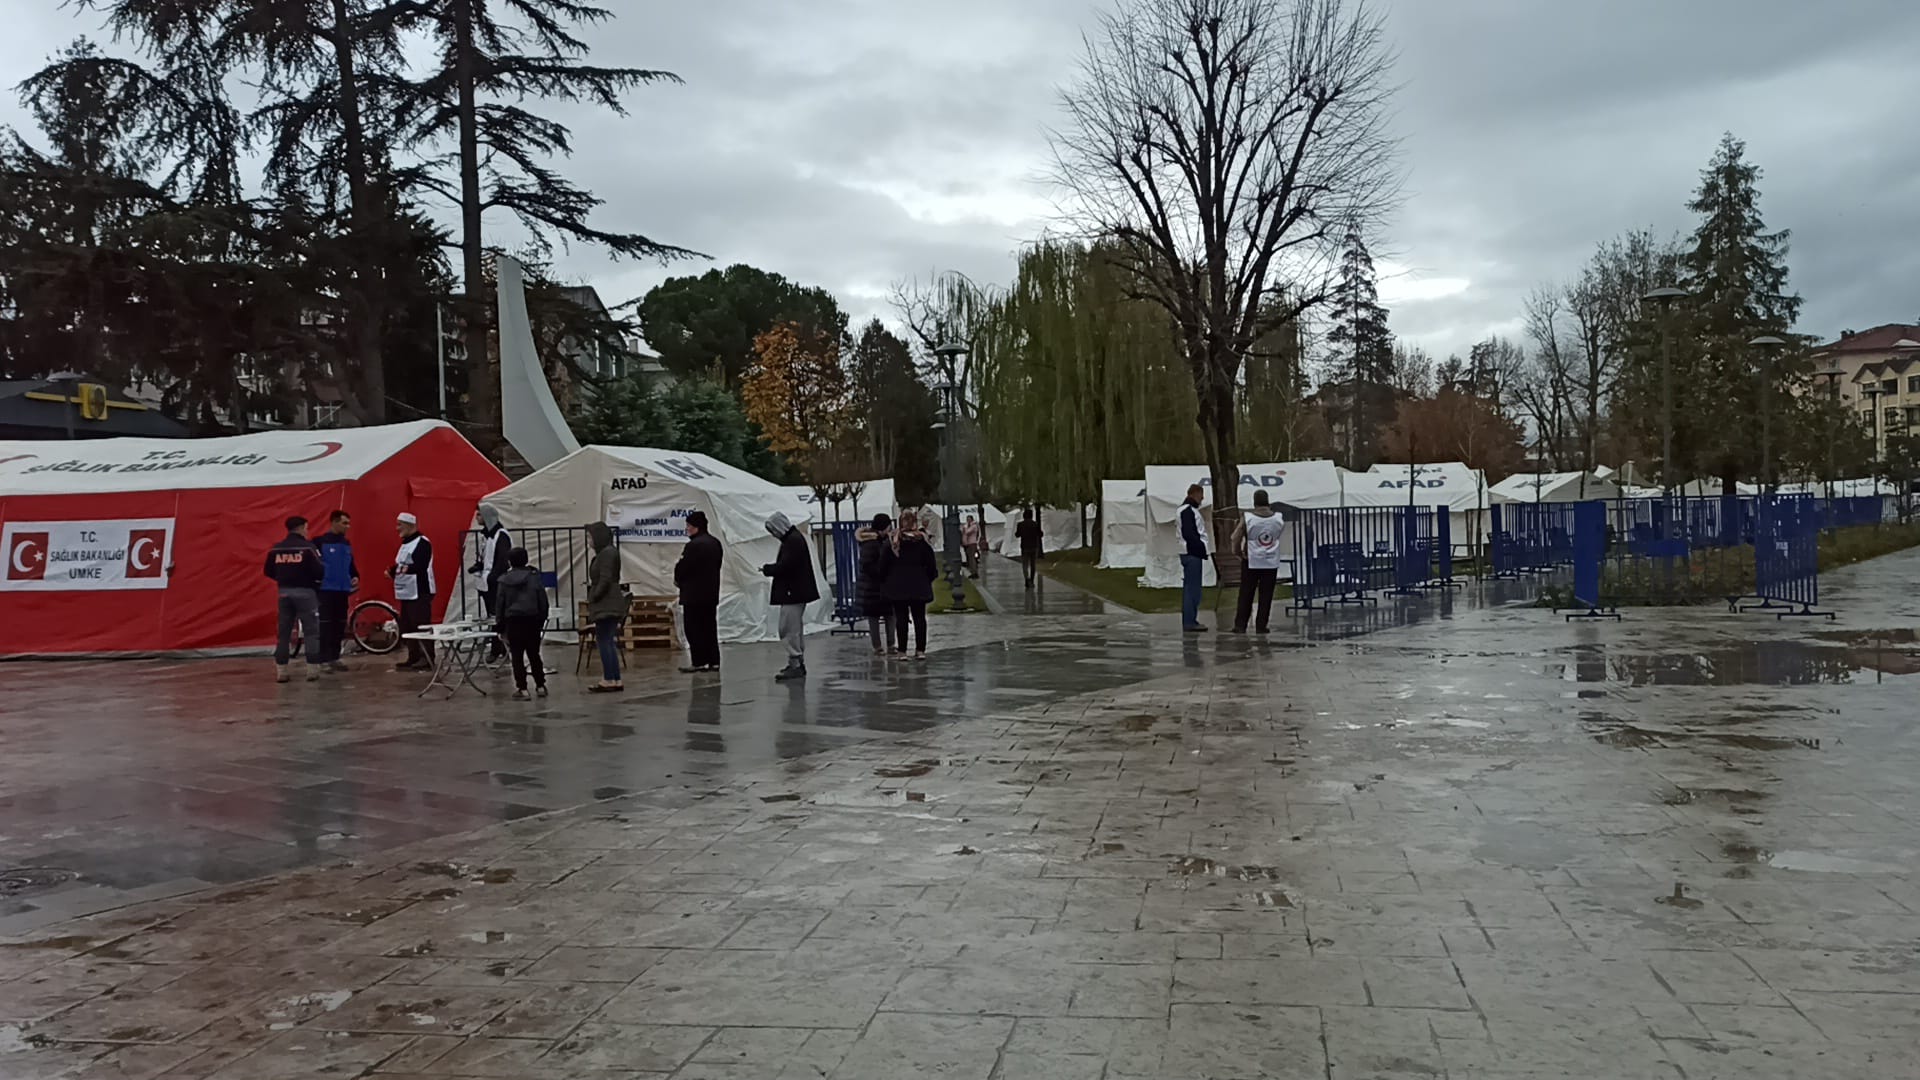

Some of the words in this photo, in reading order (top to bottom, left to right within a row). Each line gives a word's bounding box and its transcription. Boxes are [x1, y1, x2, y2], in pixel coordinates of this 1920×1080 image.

[116, 454, 268, 473] BAKANLIĞI
[611, 477, 647, 490] AFAD
[1378, 480, 1445, 489] AFAD
[80, 531, 99, 543] T.C.
[50, 549, 80, 562] SAĞLIK
[80, 547, 125, 562] BAKANLIĞI
[275, 553, 303, 564] AFAD
[69, 567, 102, 579] UMKE
